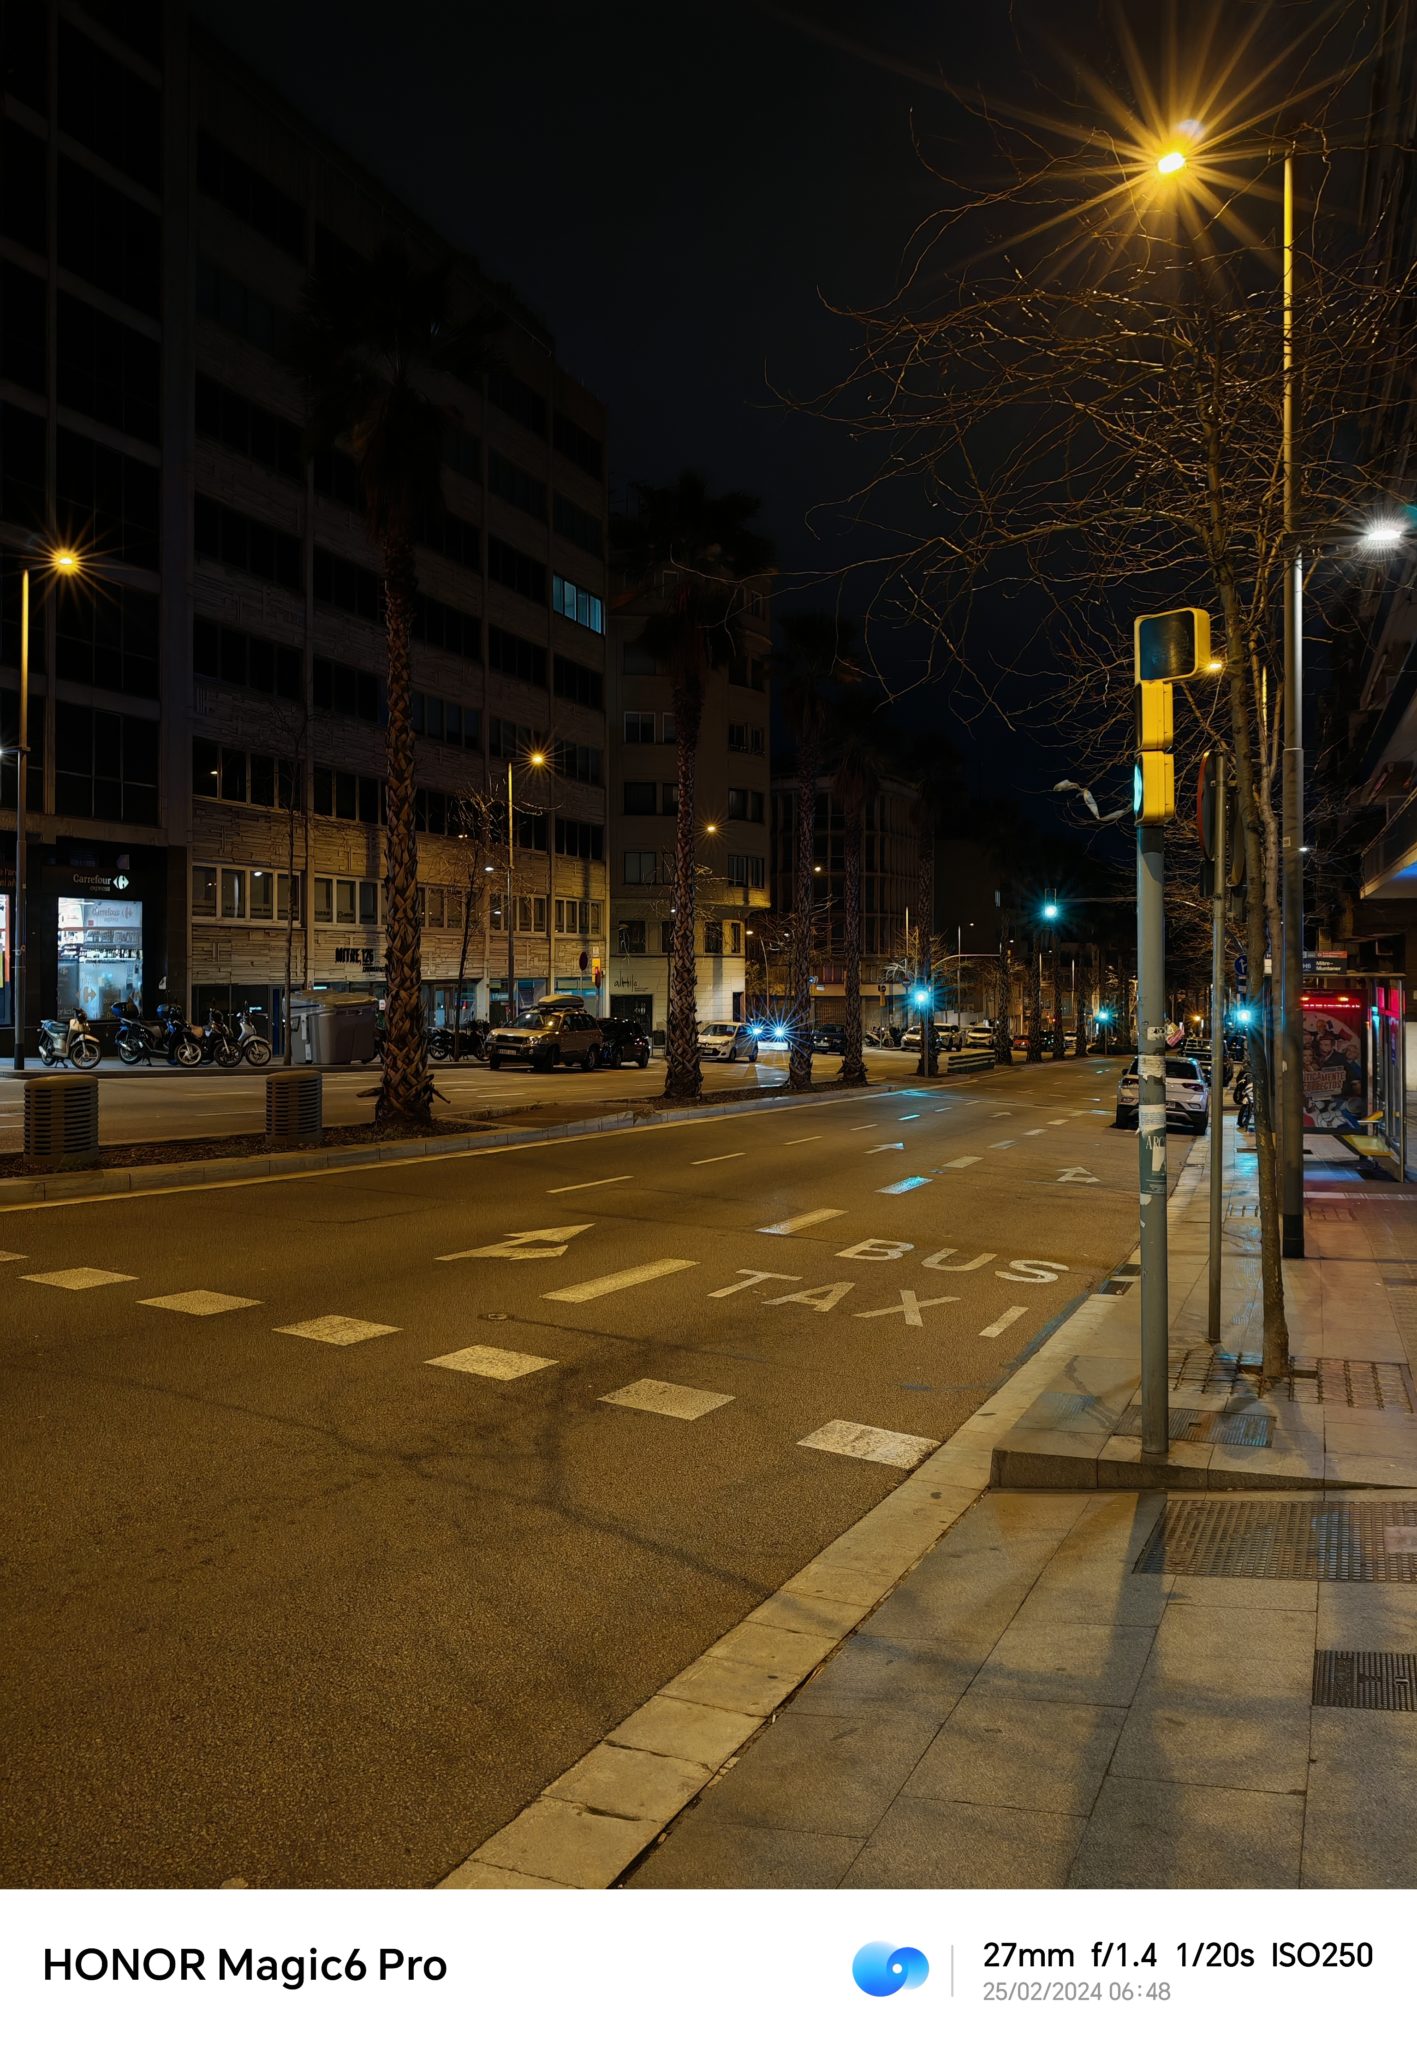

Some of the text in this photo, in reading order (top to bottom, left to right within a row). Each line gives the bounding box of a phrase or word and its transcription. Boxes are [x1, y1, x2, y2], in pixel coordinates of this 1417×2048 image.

[72, 873, 112, 886] Carrefour
[834, 1238, 1070, 1283] BUS
[706, 1268, 1029, 1338] TAXI
